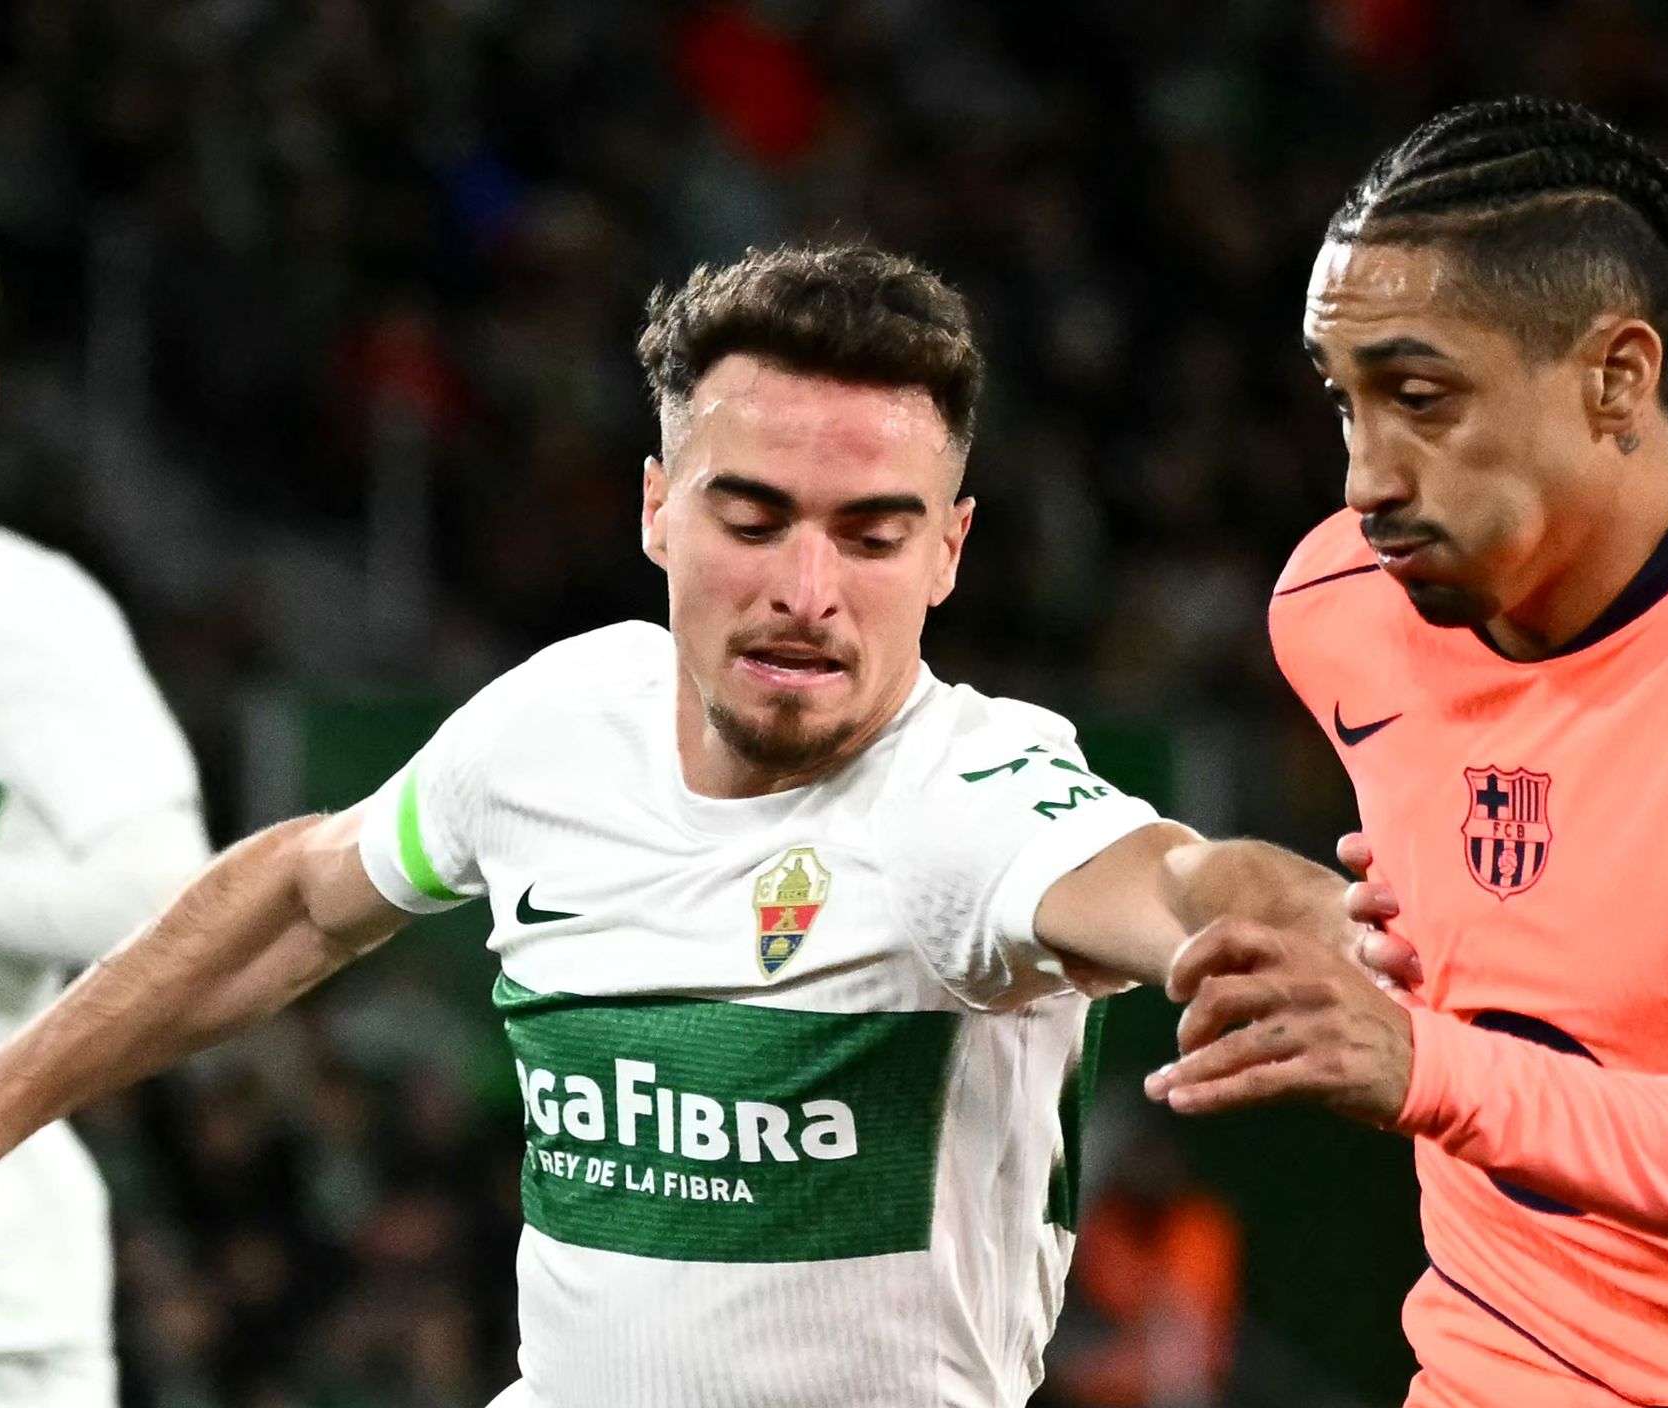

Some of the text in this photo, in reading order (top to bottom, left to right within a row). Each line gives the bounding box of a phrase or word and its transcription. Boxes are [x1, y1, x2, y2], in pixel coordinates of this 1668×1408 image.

[1492, 820, 1526, 839] FCB
[537, 1149, 581, 1180] REY
[584, 1157, 617, 1187] DE
[624, 1164, 656, 1195] LA
[663, 1171, 755, 1203] FIBRA
